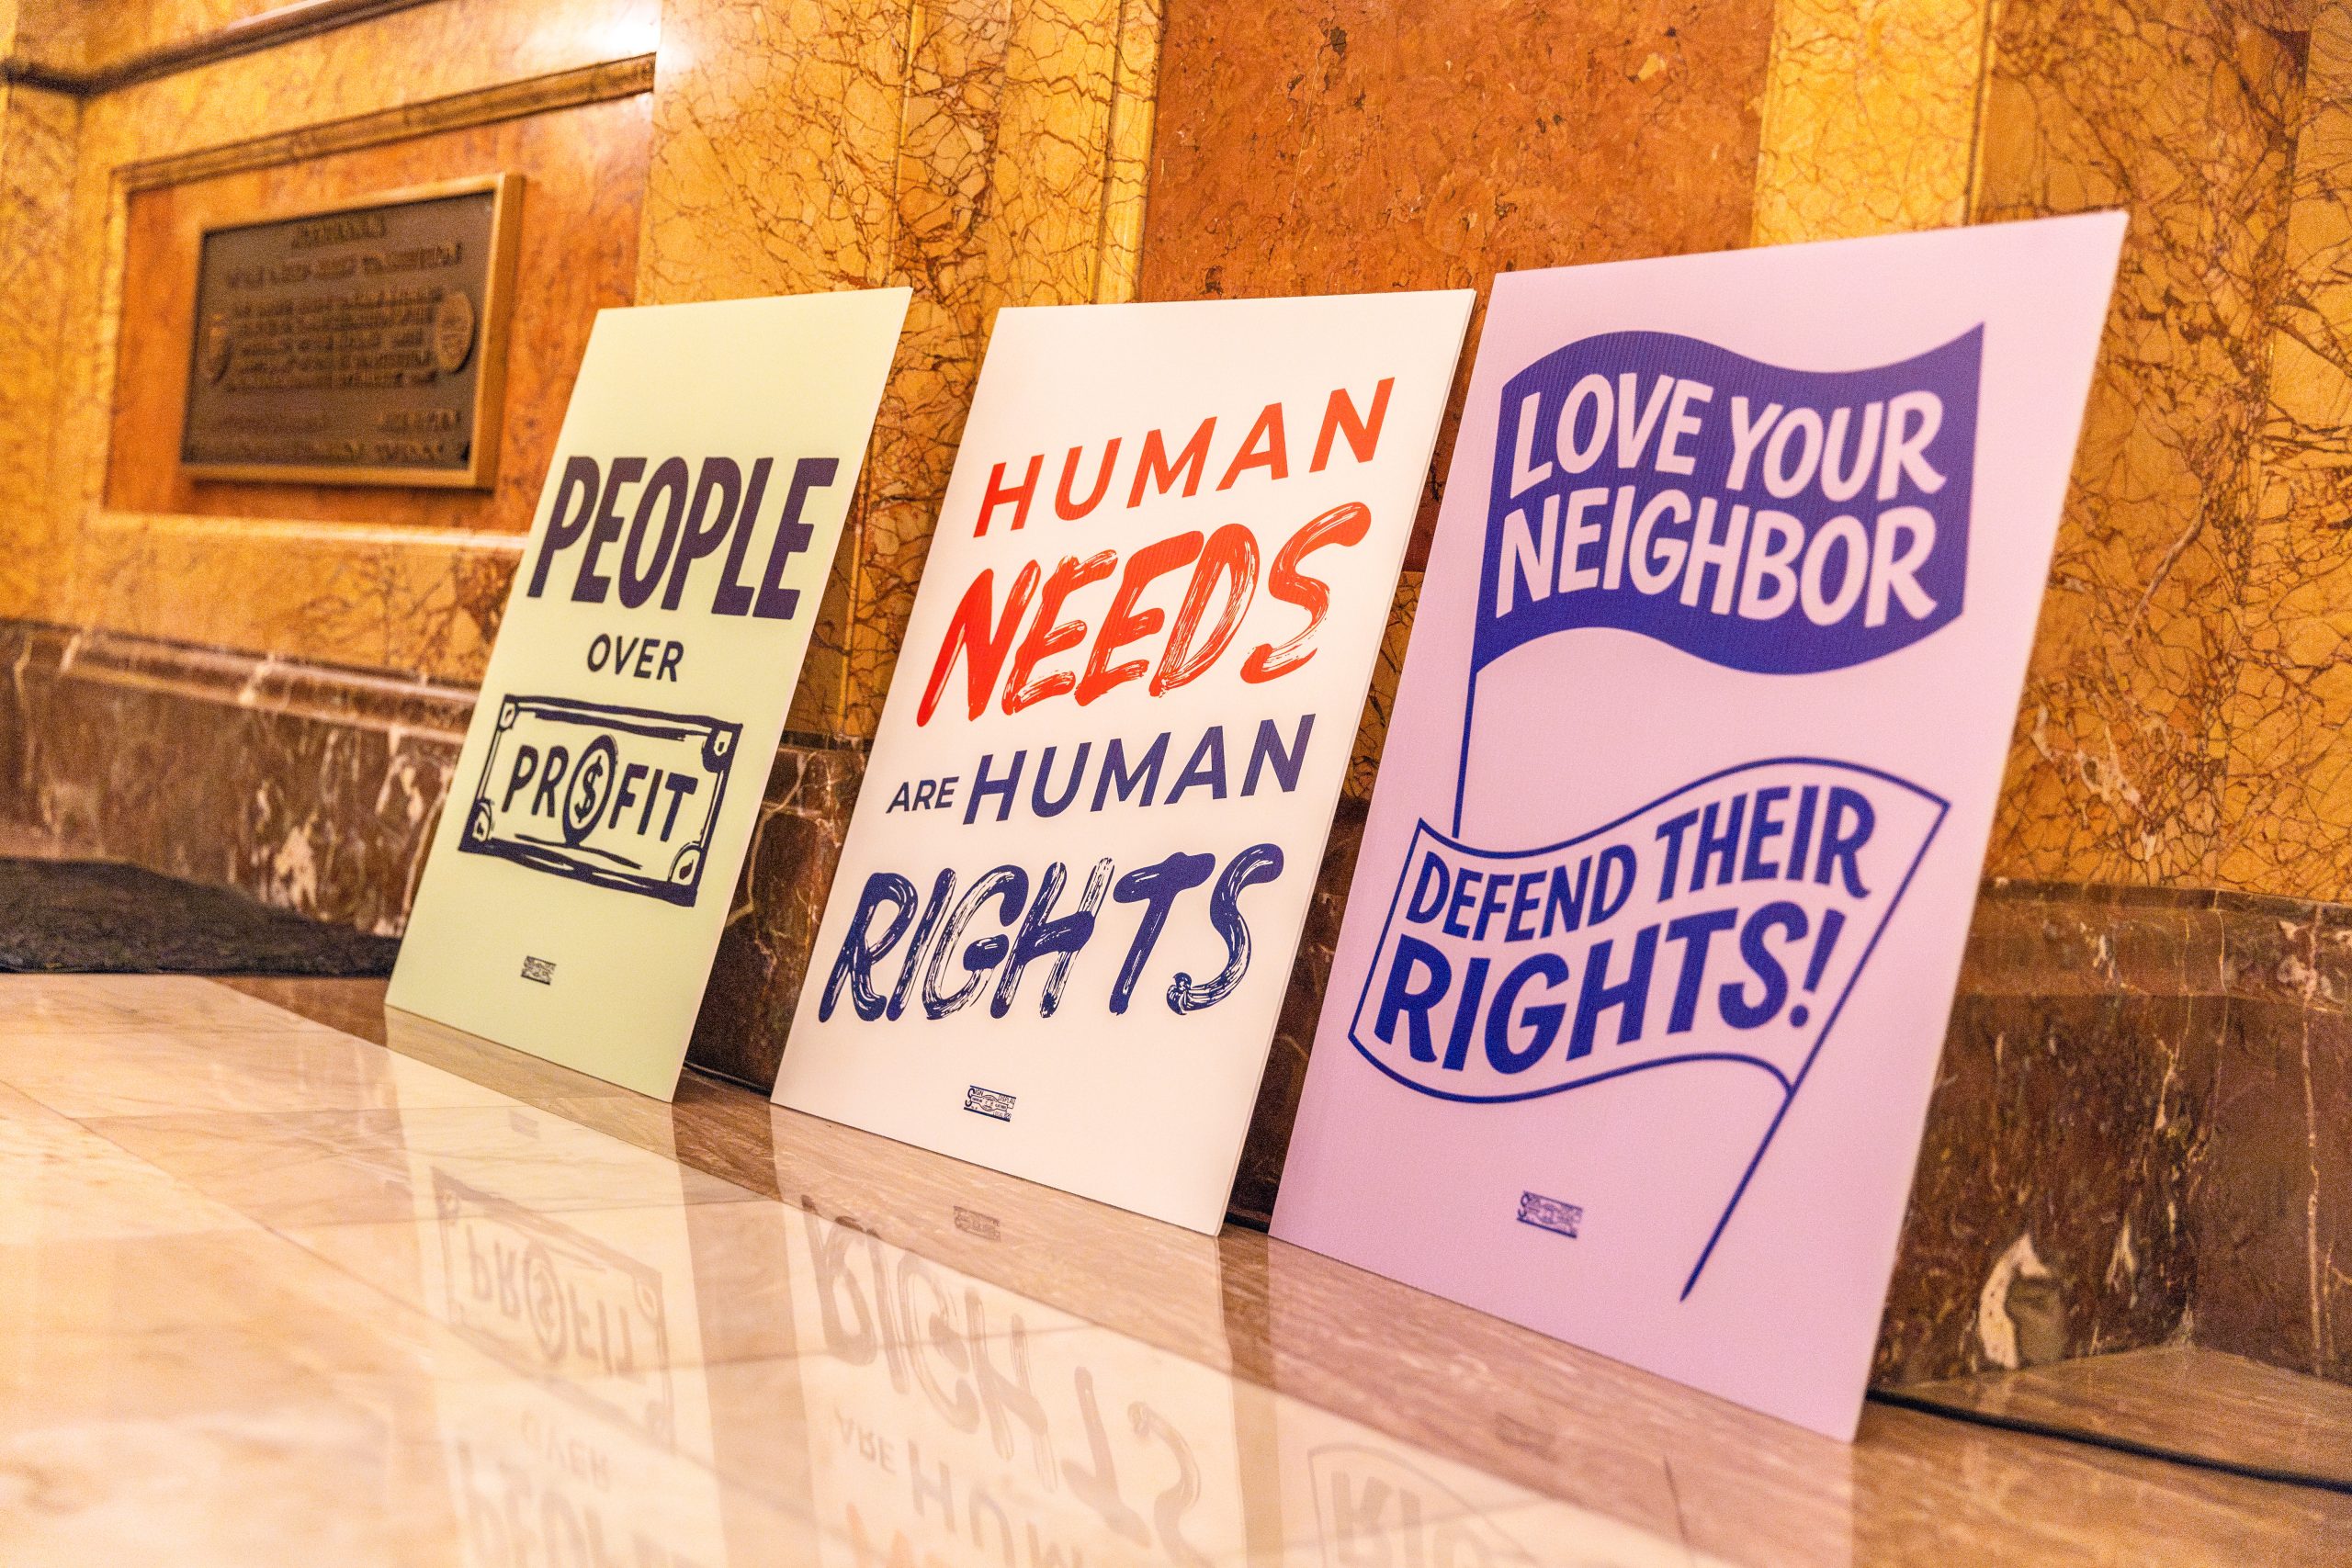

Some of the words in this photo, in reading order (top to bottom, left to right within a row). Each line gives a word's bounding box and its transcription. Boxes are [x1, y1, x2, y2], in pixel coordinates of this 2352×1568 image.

[973, 377, 1395, 538] HUMAN
[1510, 372, 1713, 498] LOVE
[1725, 390, 1946, 502] YOUR
[526, 456, 839, 620] PEOPLE
[917, 502, 1372, 728] NEEDS
[1496, 485, 1938, 627] NEIGHBOR
[587, 633, 684, 682] OVER
[886, 776, 959, 814] ARE
[962, 714, 1316, 825] HUMAN
[818, 843, 1284, 1023] RIGHTS
[1406, 843, 1637, 942] DEFEND
[1656, 785, 1876, 904] THEIR
[1374, 901, 1847, 1075] RIGHTS!
